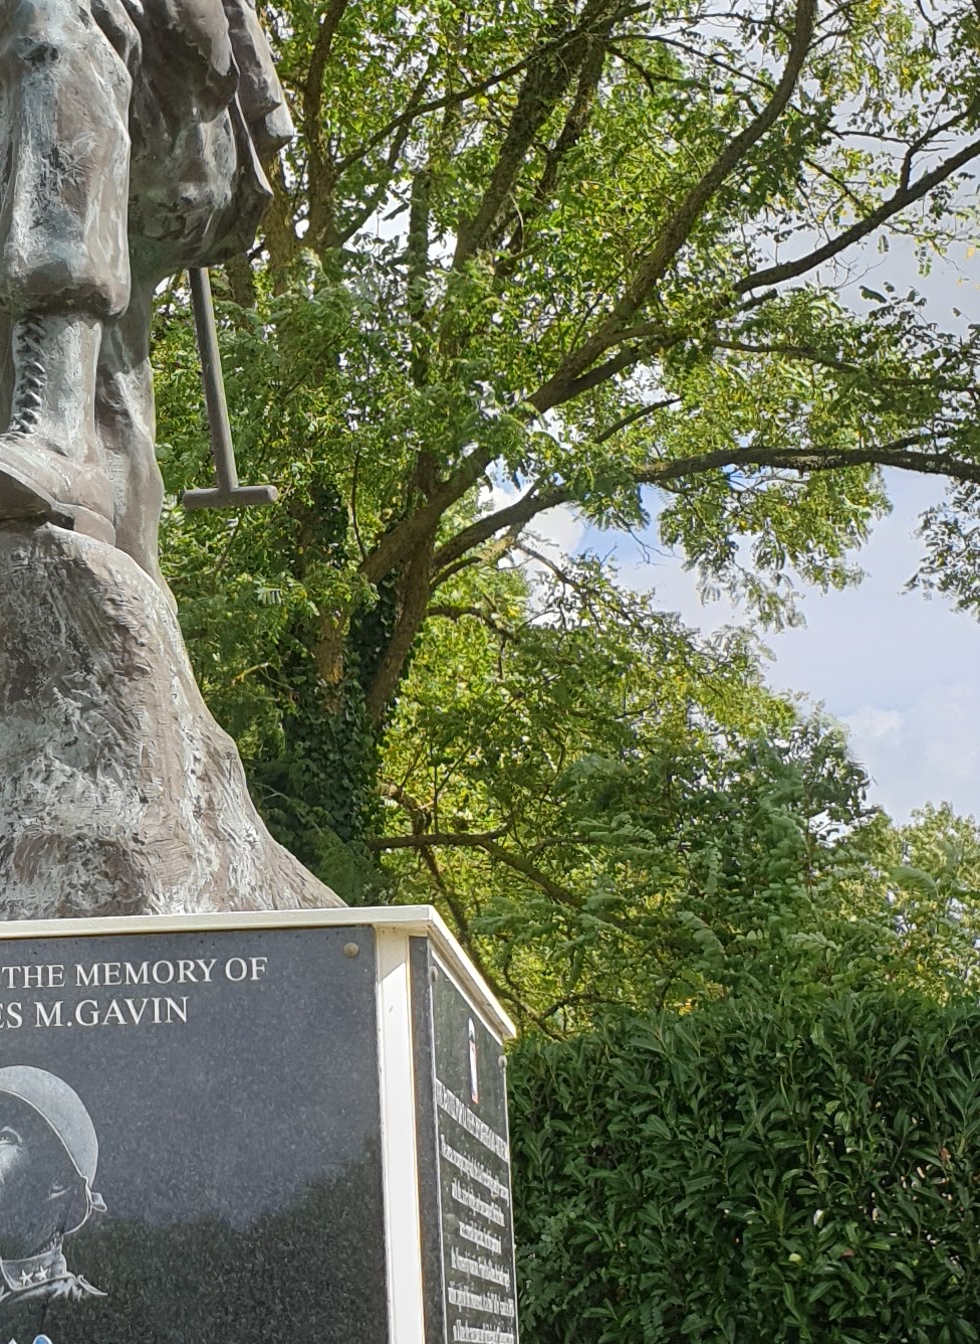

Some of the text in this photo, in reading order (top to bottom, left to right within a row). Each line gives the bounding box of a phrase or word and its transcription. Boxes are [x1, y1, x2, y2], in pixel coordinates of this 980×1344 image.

[1, 964, 66, 989] THE
[74, 958, 218, 987] MEMORY
[225, 956, 268, 982] OF
[33, 996, 190, 1028] M.GAVIN
